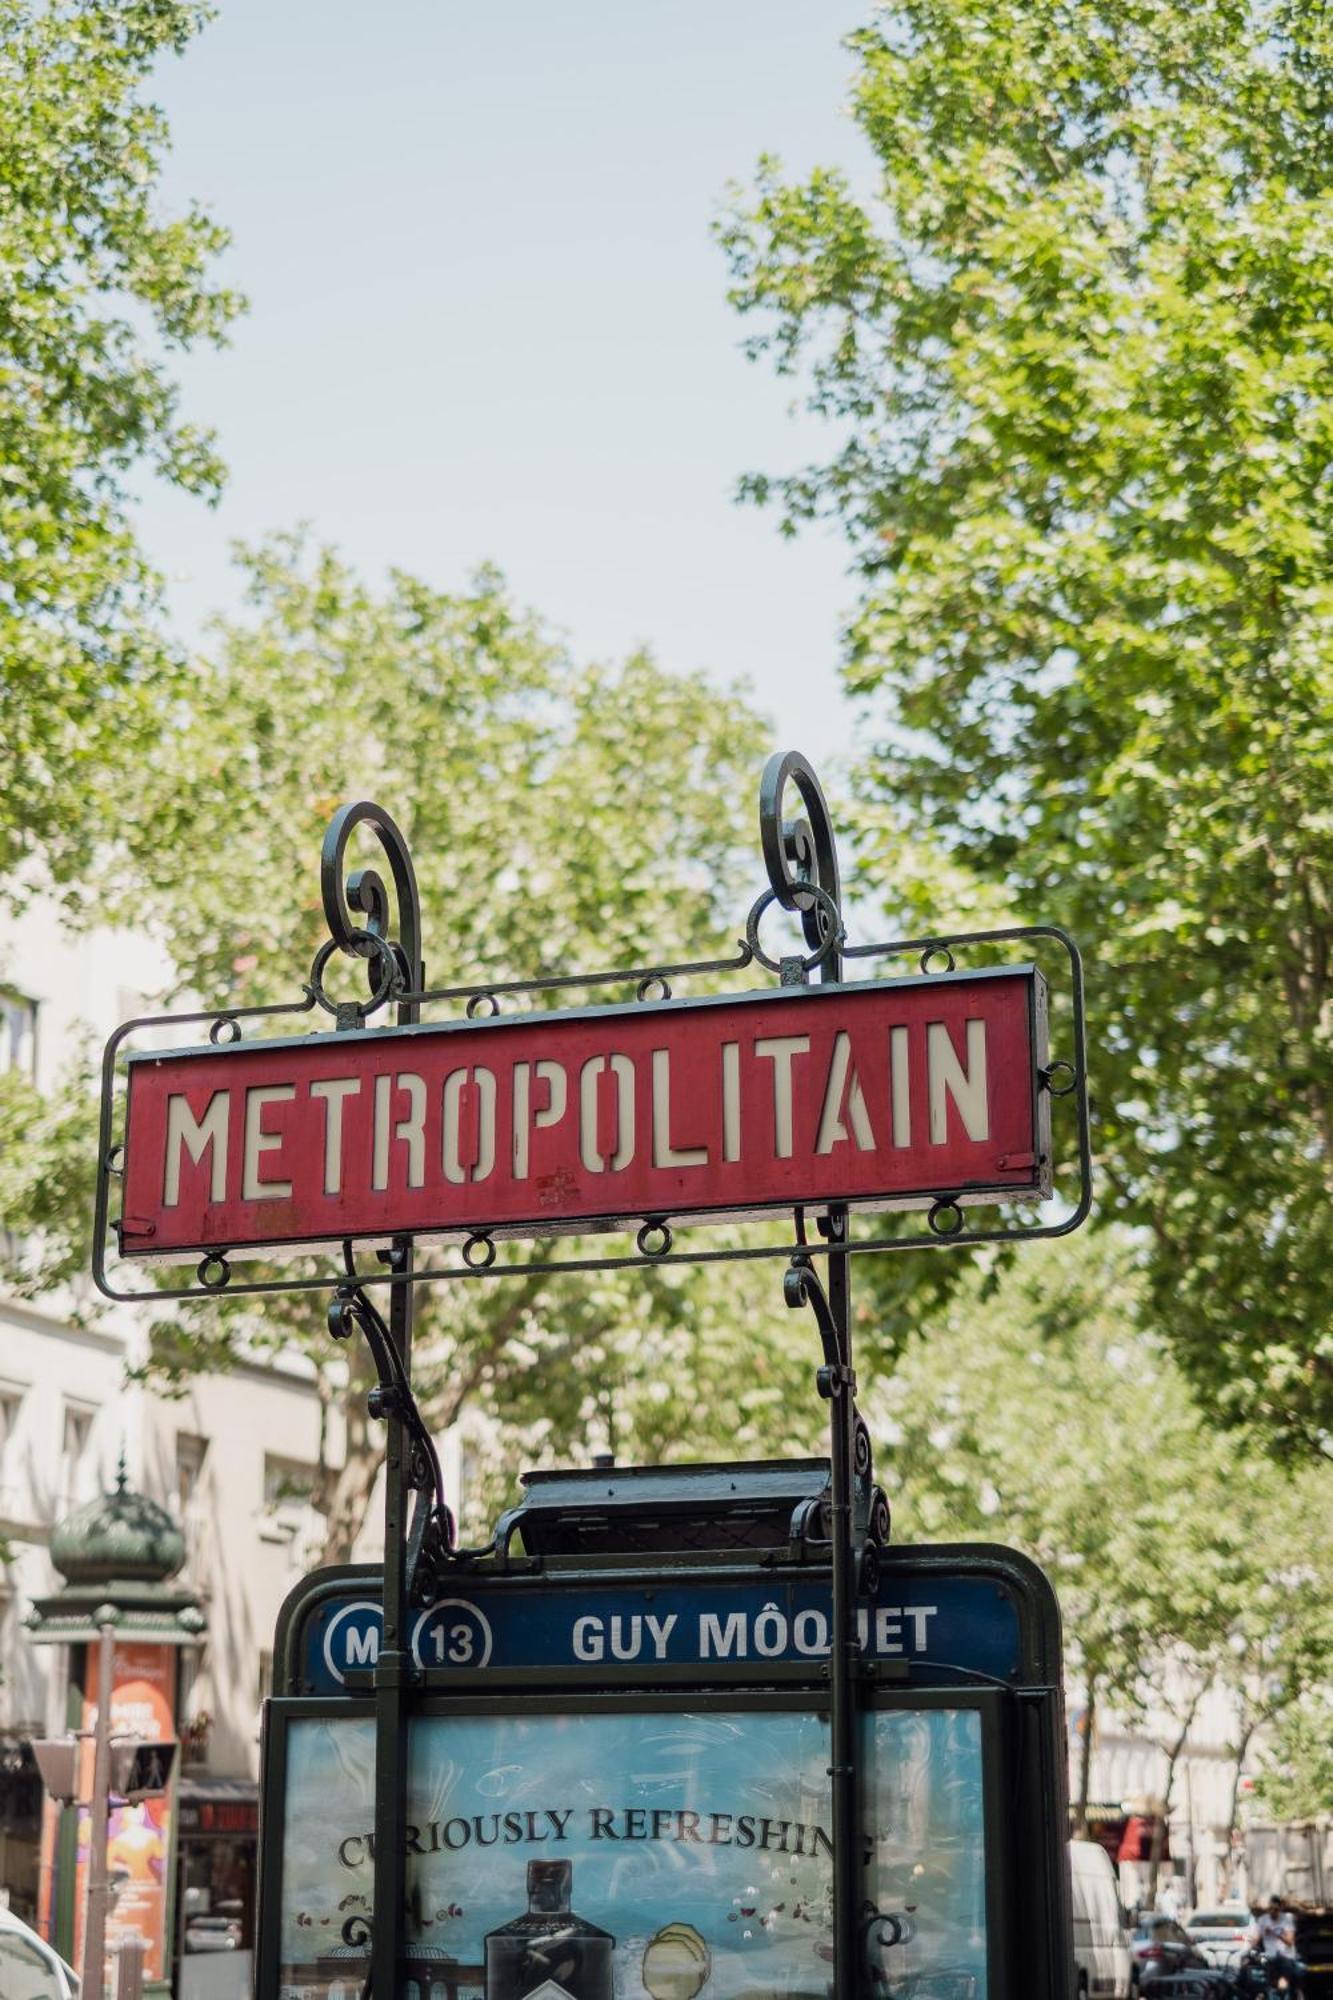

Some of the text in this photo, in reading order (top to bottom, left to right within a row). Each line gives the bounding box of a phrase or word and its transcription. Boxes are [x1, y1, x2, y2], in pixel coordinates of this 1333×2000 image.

[162, 1017, 991, 1208] METROPOLITAIN
[345, 1626, 378, 1665] M
[429, 1624, 474, 1663] 13
[572, 1613, 679, 1662] GUY
[587, 1807, 875, 1866] REFRESHIN
